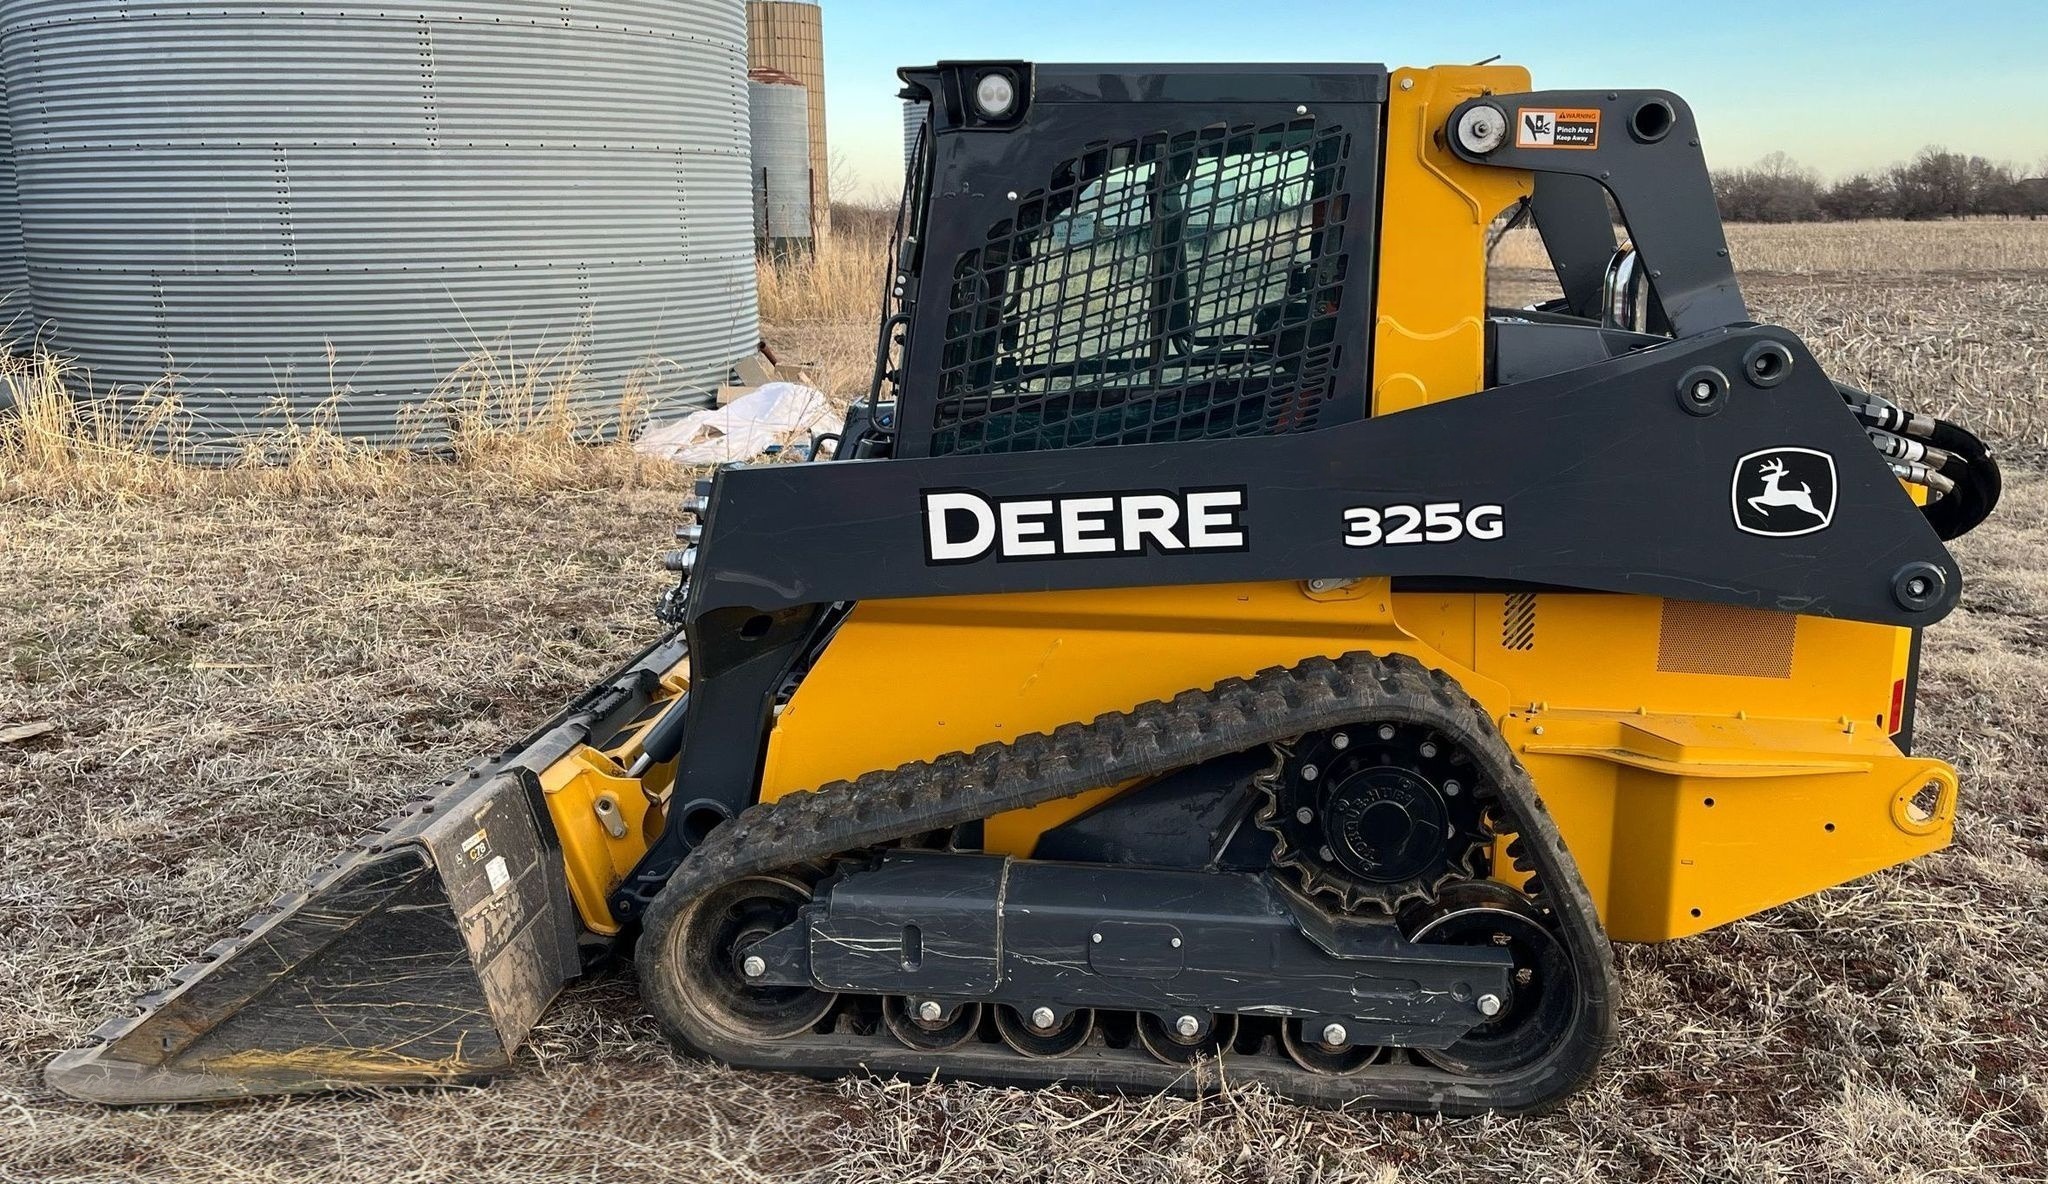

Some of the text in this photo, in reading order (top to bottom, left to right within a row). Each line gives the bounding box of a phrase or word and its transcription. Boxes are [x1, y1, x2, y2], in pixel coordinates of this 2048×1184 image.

[1577, 126, 1594, 134] Area
[1556, 134, 1571, 142] Keep
[927, 490, 1505, 560] DEERE 325G
[469, 842, 486, 860] C78
